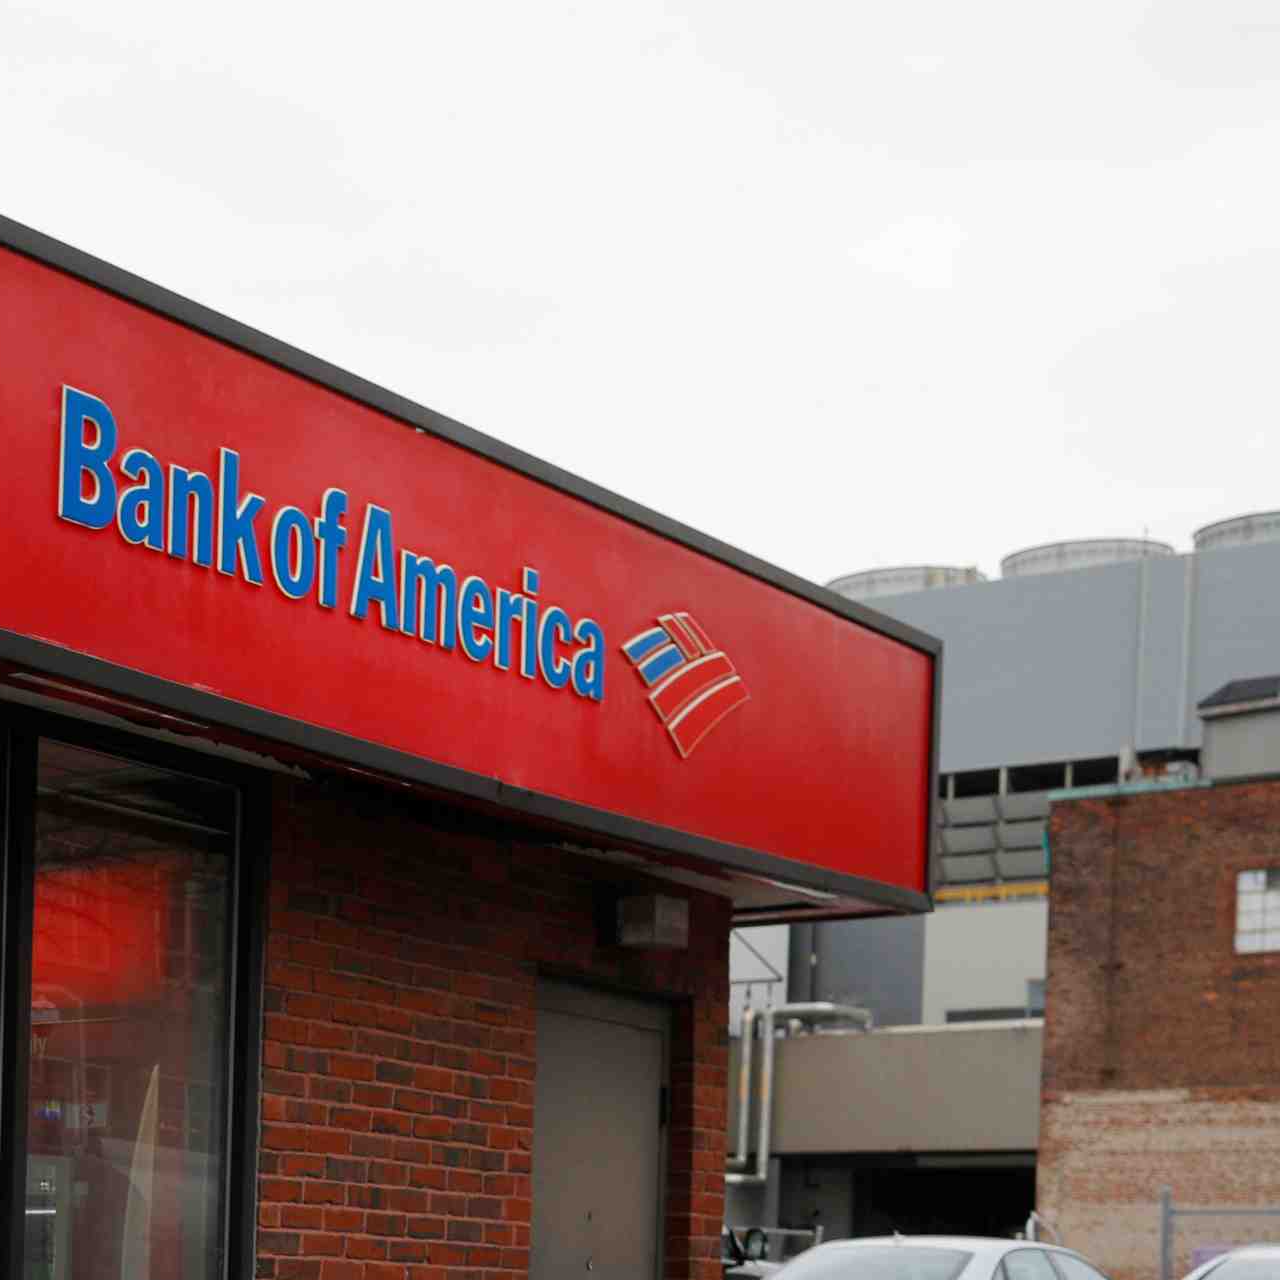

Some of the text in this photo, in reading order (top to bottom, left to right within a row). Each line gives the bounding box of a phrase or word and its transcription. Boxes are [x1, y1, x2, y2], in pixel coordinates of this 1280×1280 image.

[57, 383, 606, 701] Bank of America
